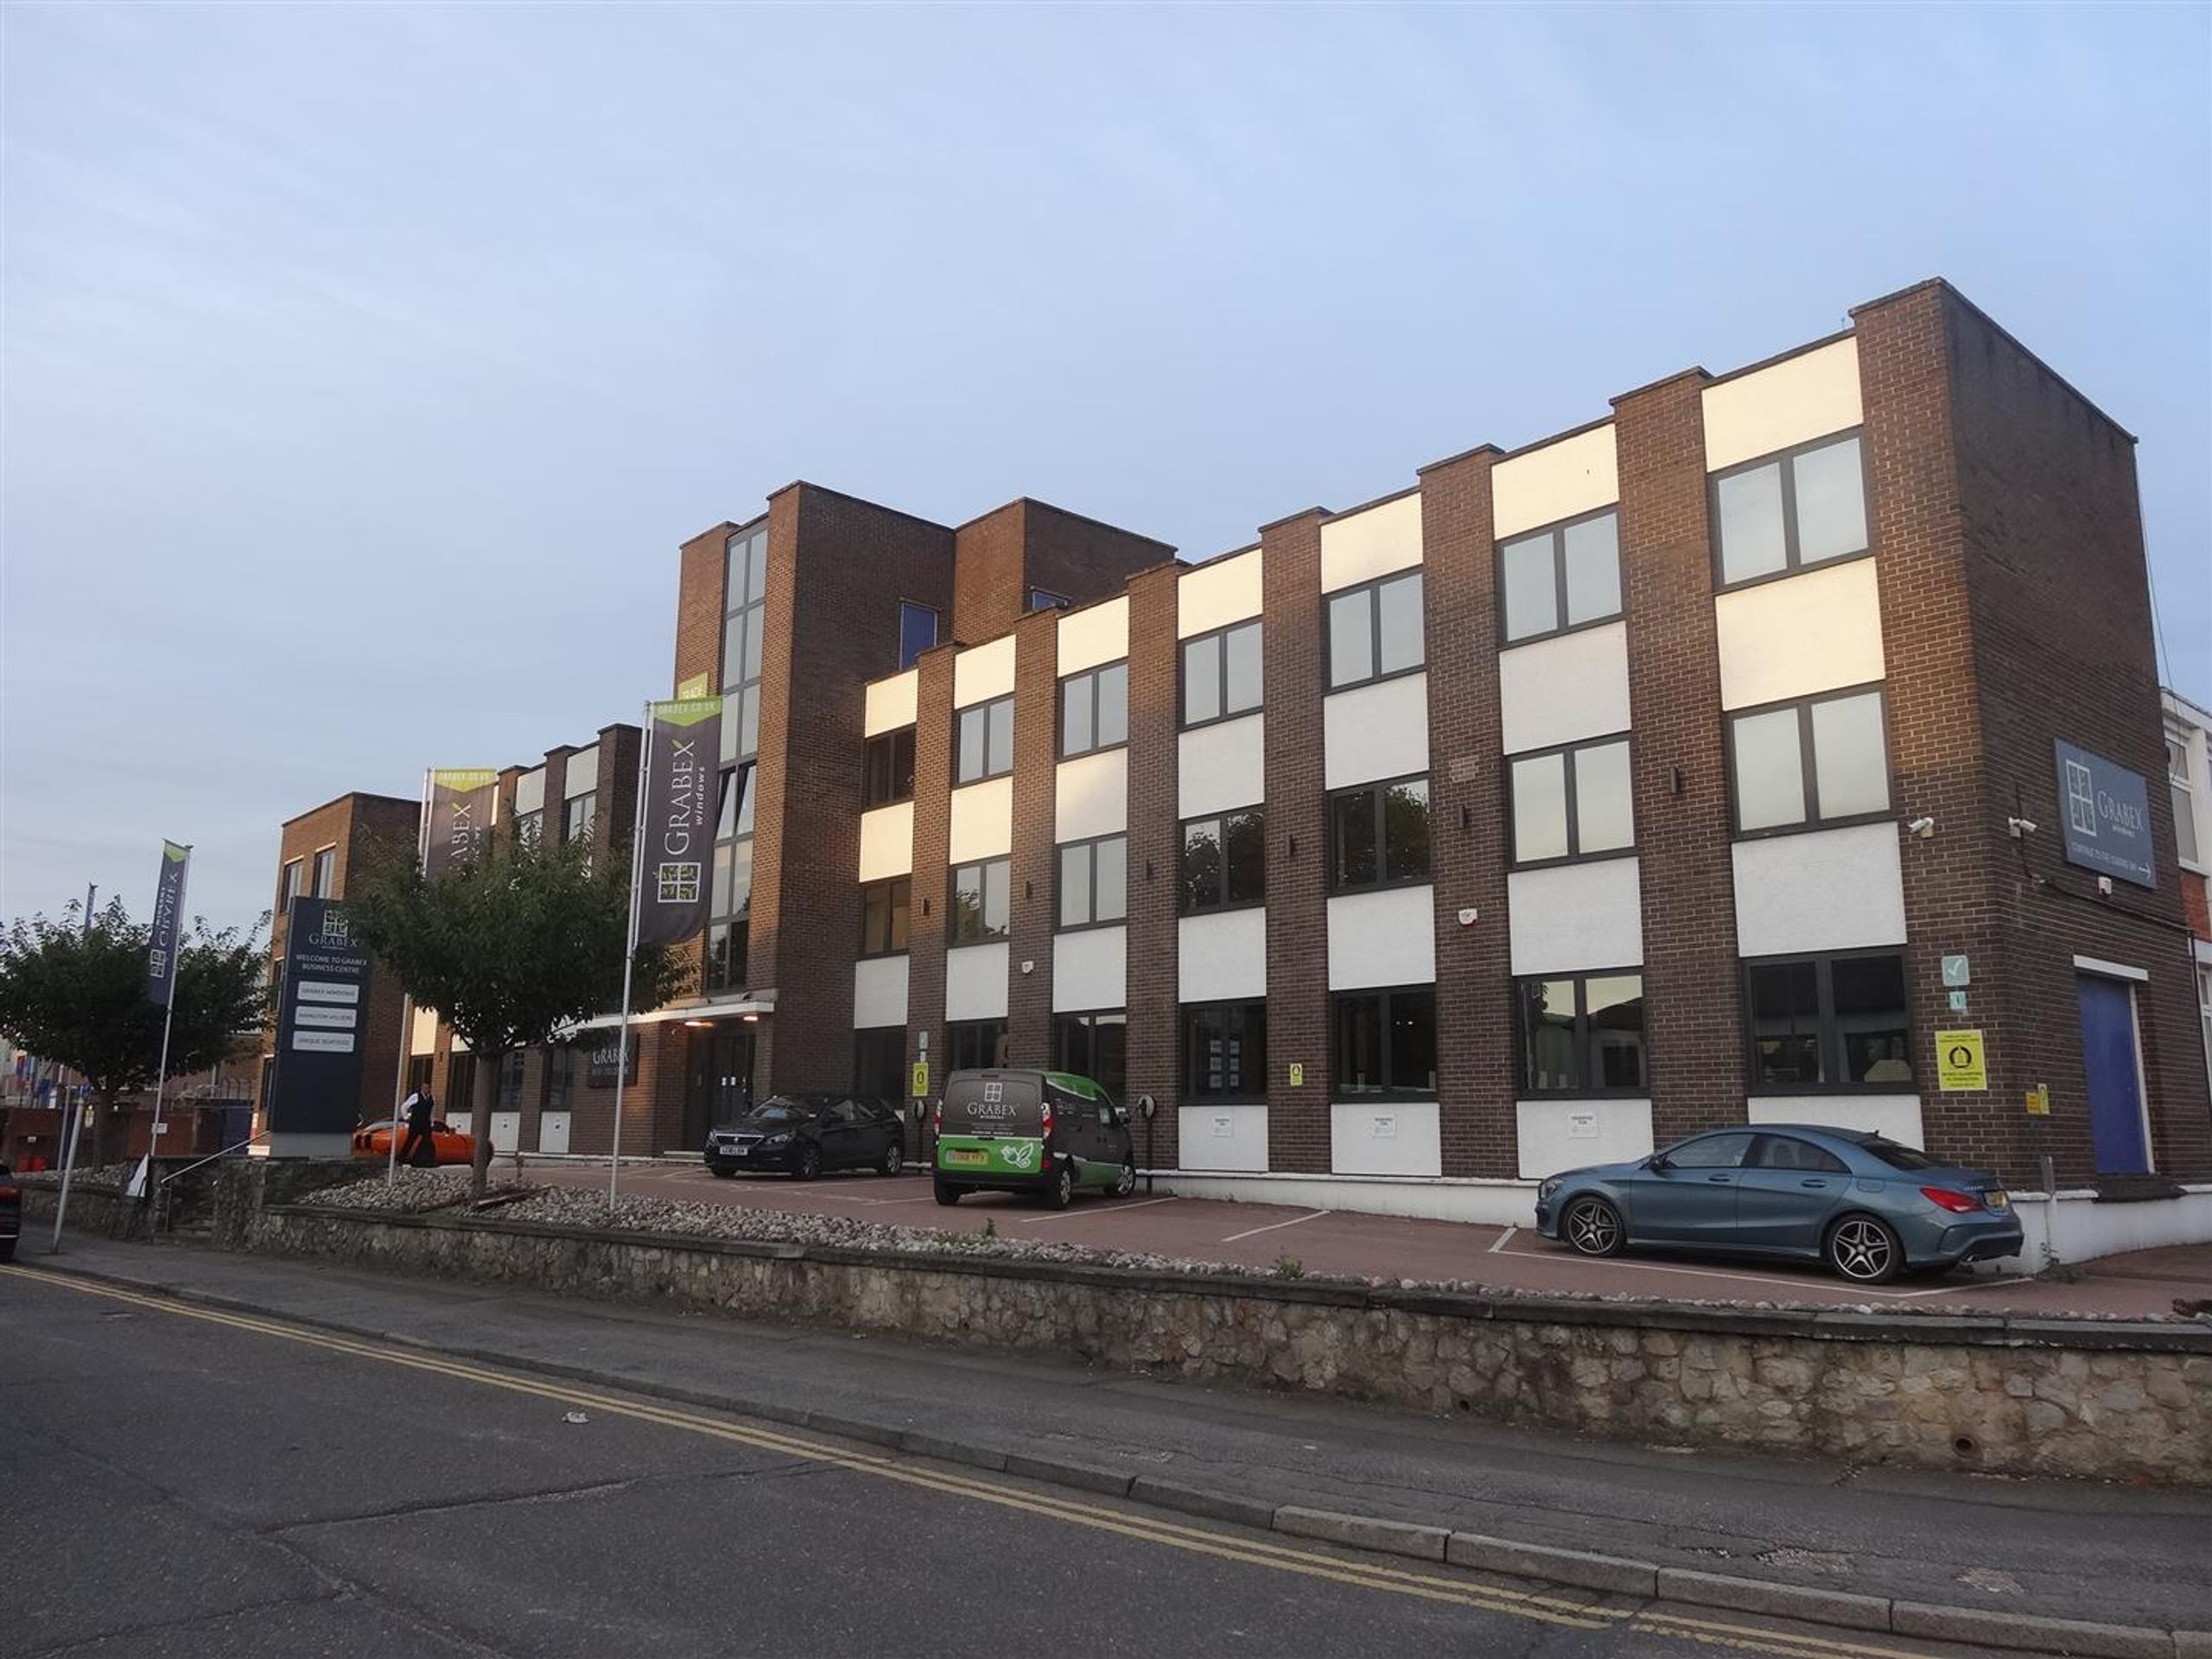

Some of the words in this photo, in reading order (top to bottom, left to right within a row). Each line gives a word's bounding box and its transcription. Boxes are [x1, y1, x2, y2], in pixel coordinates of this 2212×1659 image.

[664, 739, 696, 856] GRABEX
[694, 766, 706, 826] windows
[2097, 790, 2144, 831] GRABEX
[308, 932, 359, 948] GRABEX
[296, 953, 329, 963] WELCOME
[302, 963, 334, 972] BUSINESS
[967, 1102, 1017, 1117] GRABEX
